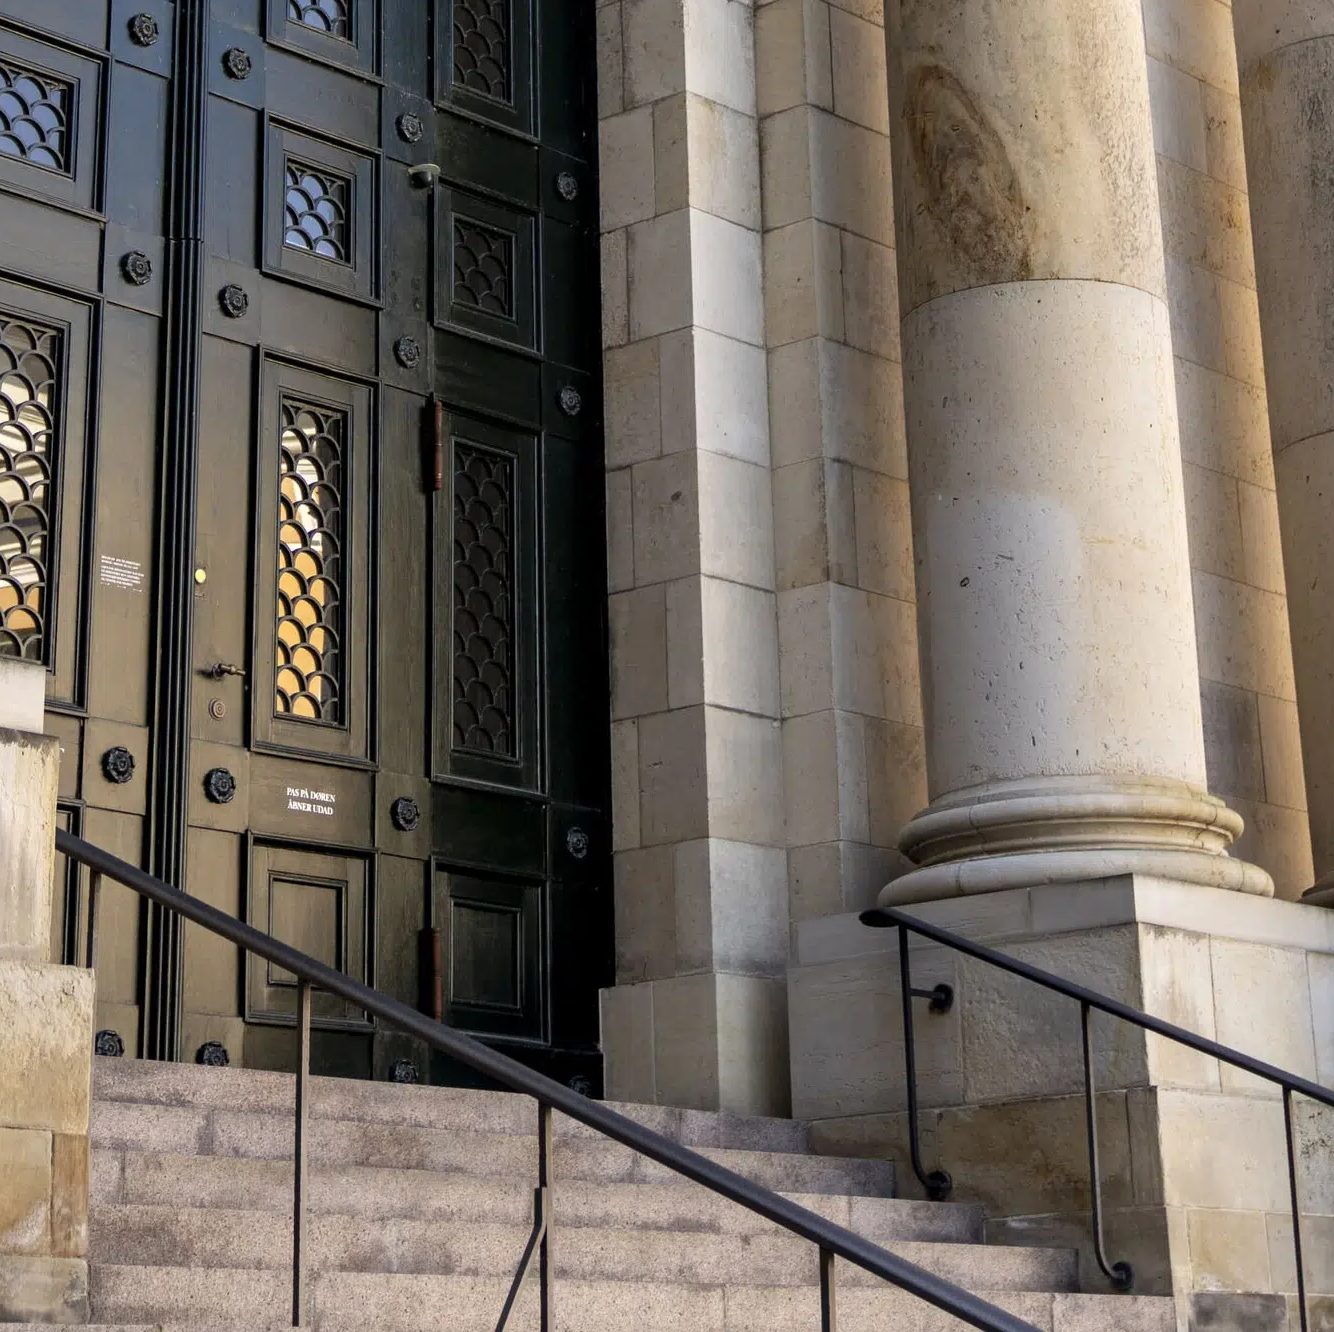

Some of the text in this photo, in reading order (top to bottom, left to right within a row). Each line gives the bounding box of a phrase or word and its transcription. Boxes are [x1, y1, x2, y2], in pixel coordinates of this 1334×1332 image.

[286, 787, 335, 802] PAS PÅ DØREN
[287, 798, 334, 815] ÅBNER UDAD
